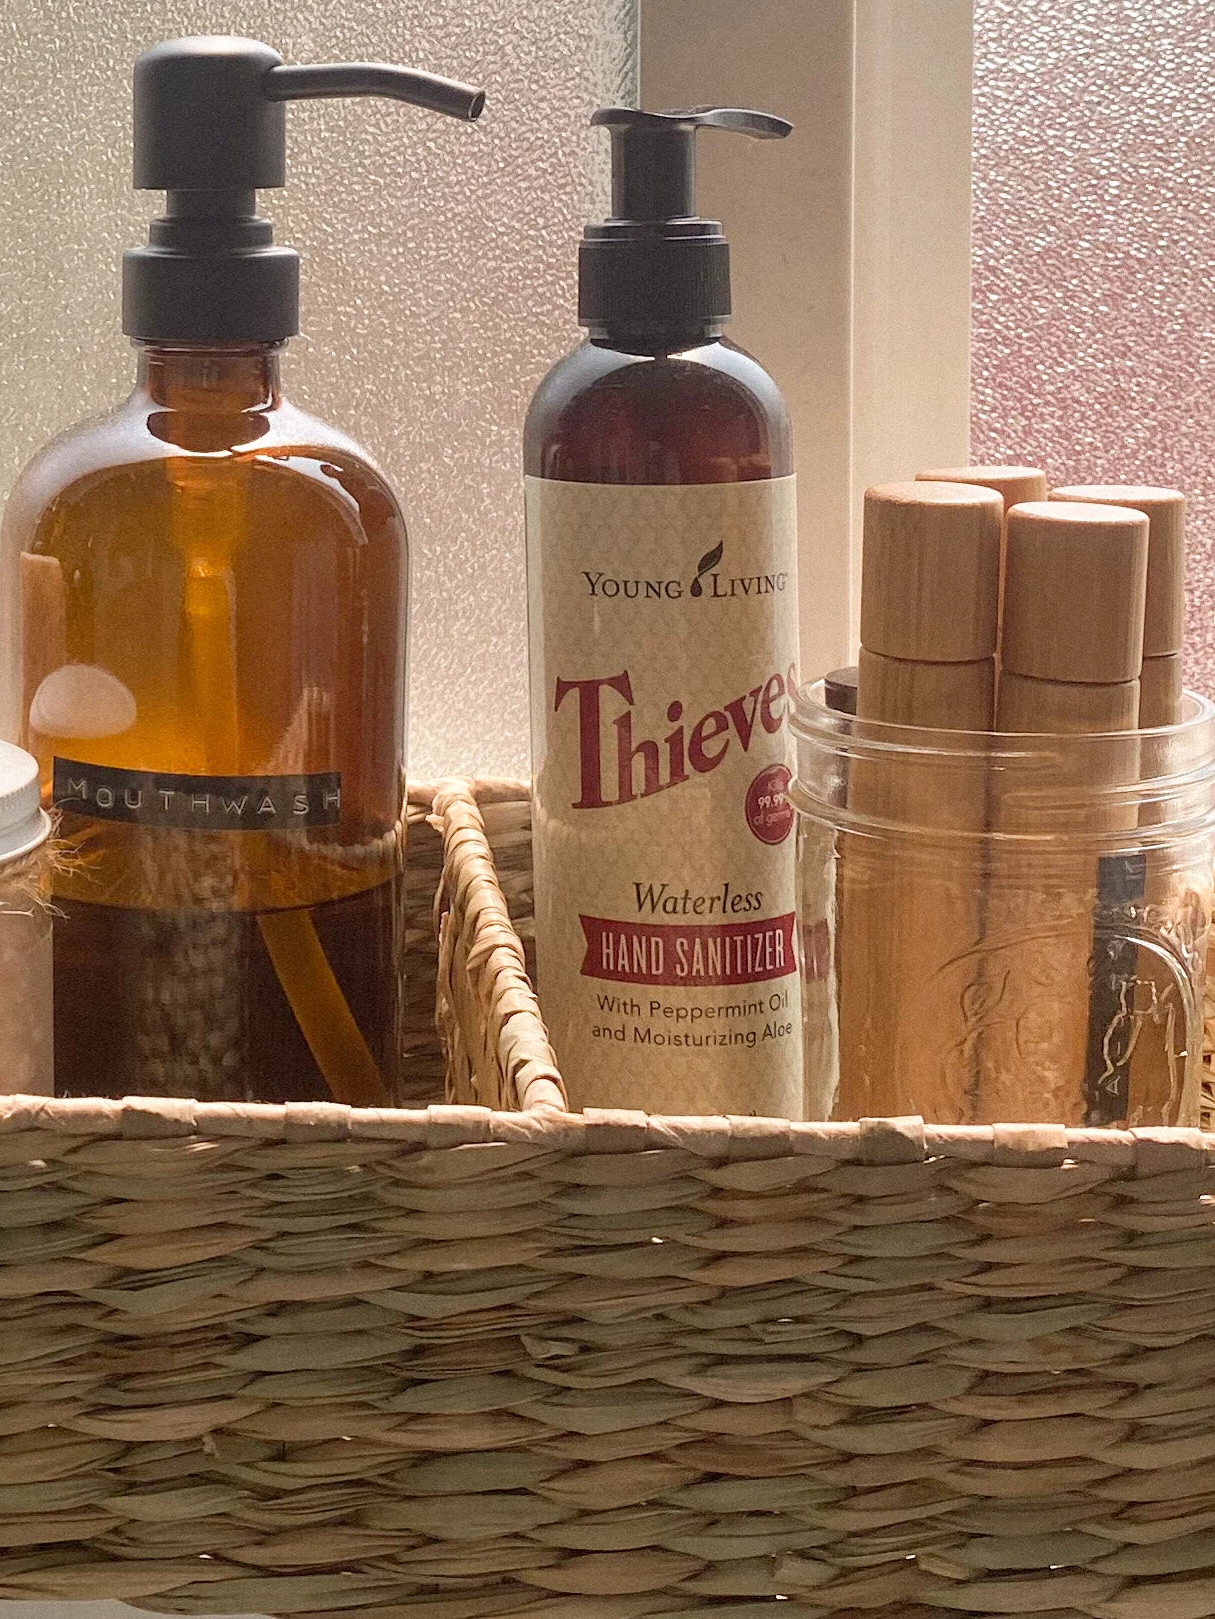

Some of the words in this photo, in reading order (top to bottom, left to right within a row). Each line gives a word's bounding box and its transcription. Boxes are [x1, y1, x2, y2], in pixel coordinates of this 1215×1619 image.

[582, 571, 684, 599] YOUNG
[710, 573, 786, 598] LIVING
[67, 778, 341, 816] MOUTHWASH
[632, 882, 763, 915] Waterless
[601, 931, 664, 976] HAND
[675, 929, 786, 978] SANITIZER
[596, 993, 641, 1017] With
[650, 999, 764, 1023] Peppermint
[768, 989, 789, 1012] Oil
[591, 1025, 626, 1042] and
[634, 1027, 757, 1048] Moisturizing
[760, 1021, 793, 1042] Aloe
